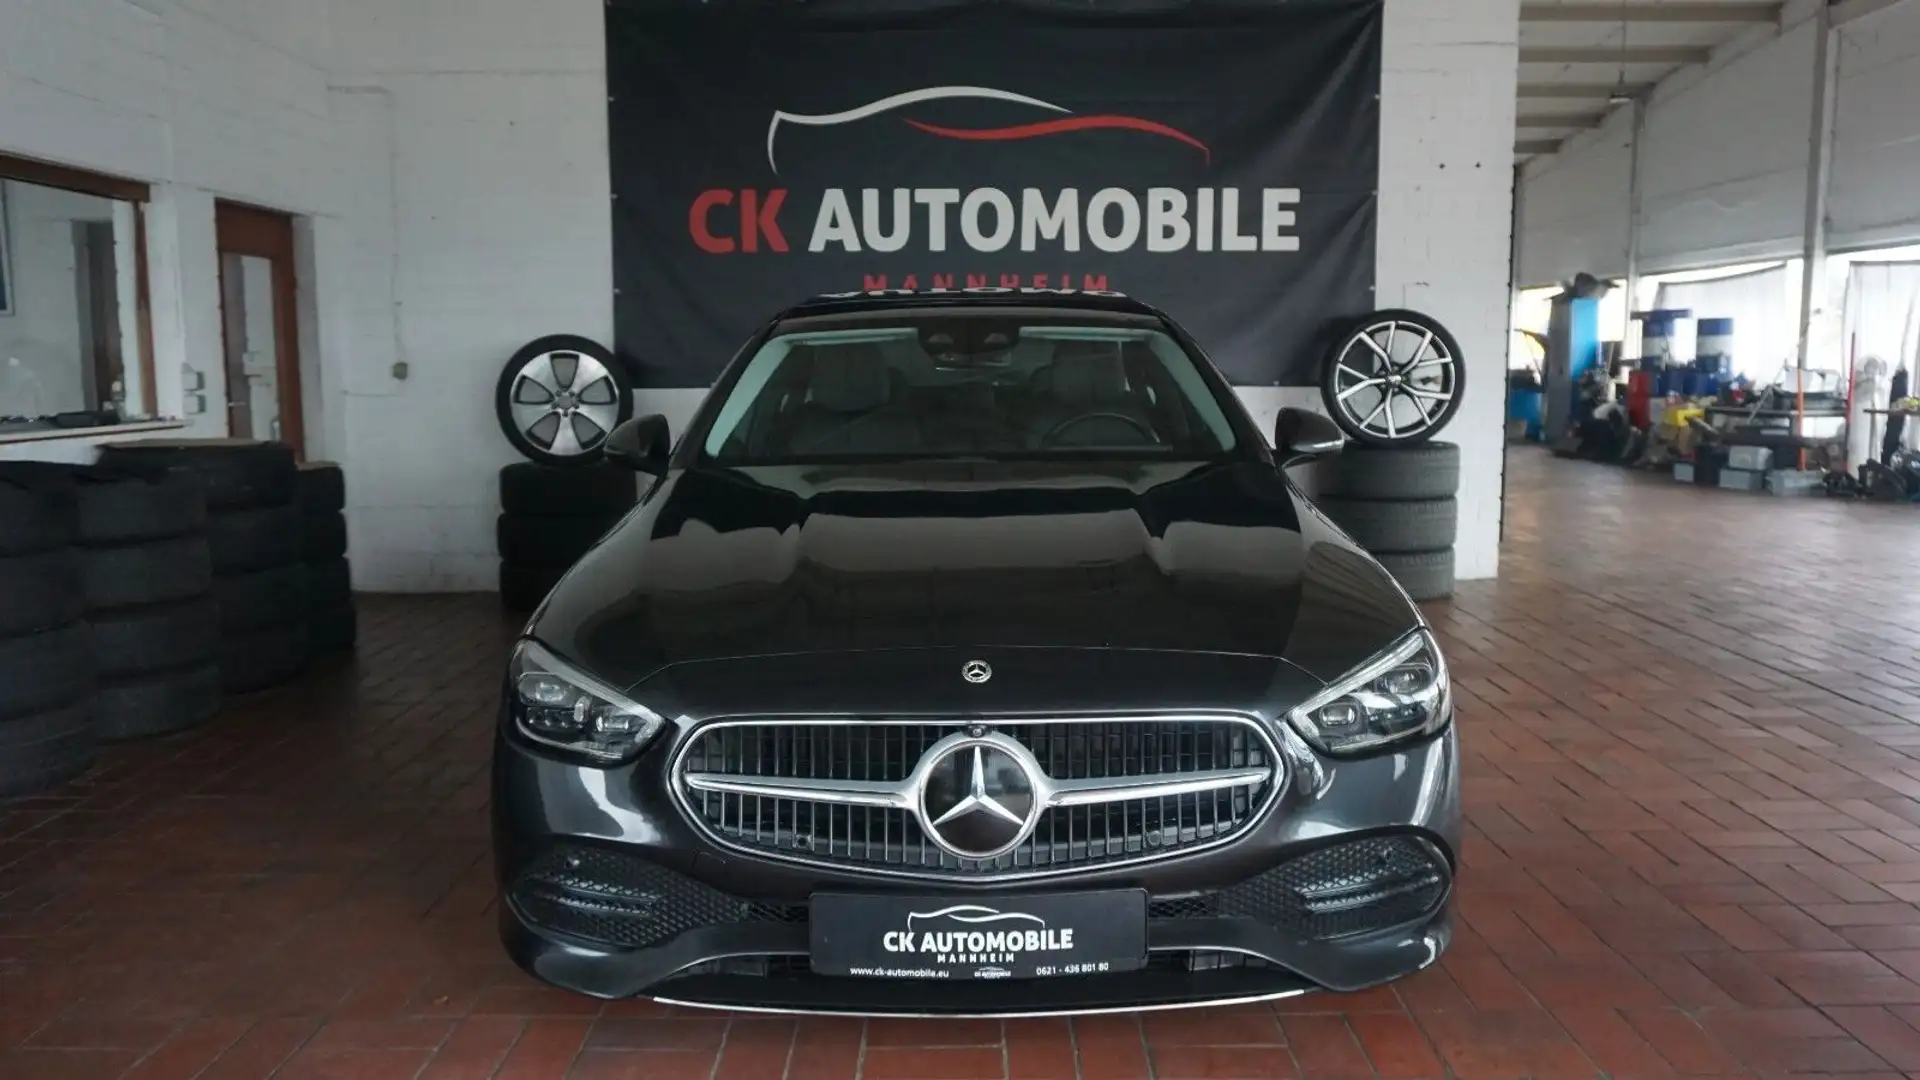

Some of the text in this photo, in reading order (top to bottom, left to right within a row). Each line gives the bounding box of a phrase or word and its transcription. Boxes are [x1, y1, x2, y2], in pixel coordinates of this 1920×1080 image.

[689, 187, 1300, 254] CK AUTOMOBILE
[883, 928, 1074, 953] CK AUTOMOBILE
[937, 953, 1014, 963] MANNHEIM
[849, 967, 950, 978] www.ck-automobile.eu
[1036, 965, 1056, 976] 0621
[1081, 963, 1096, 973] 801
[1098, 962, 1109, 972] 80
